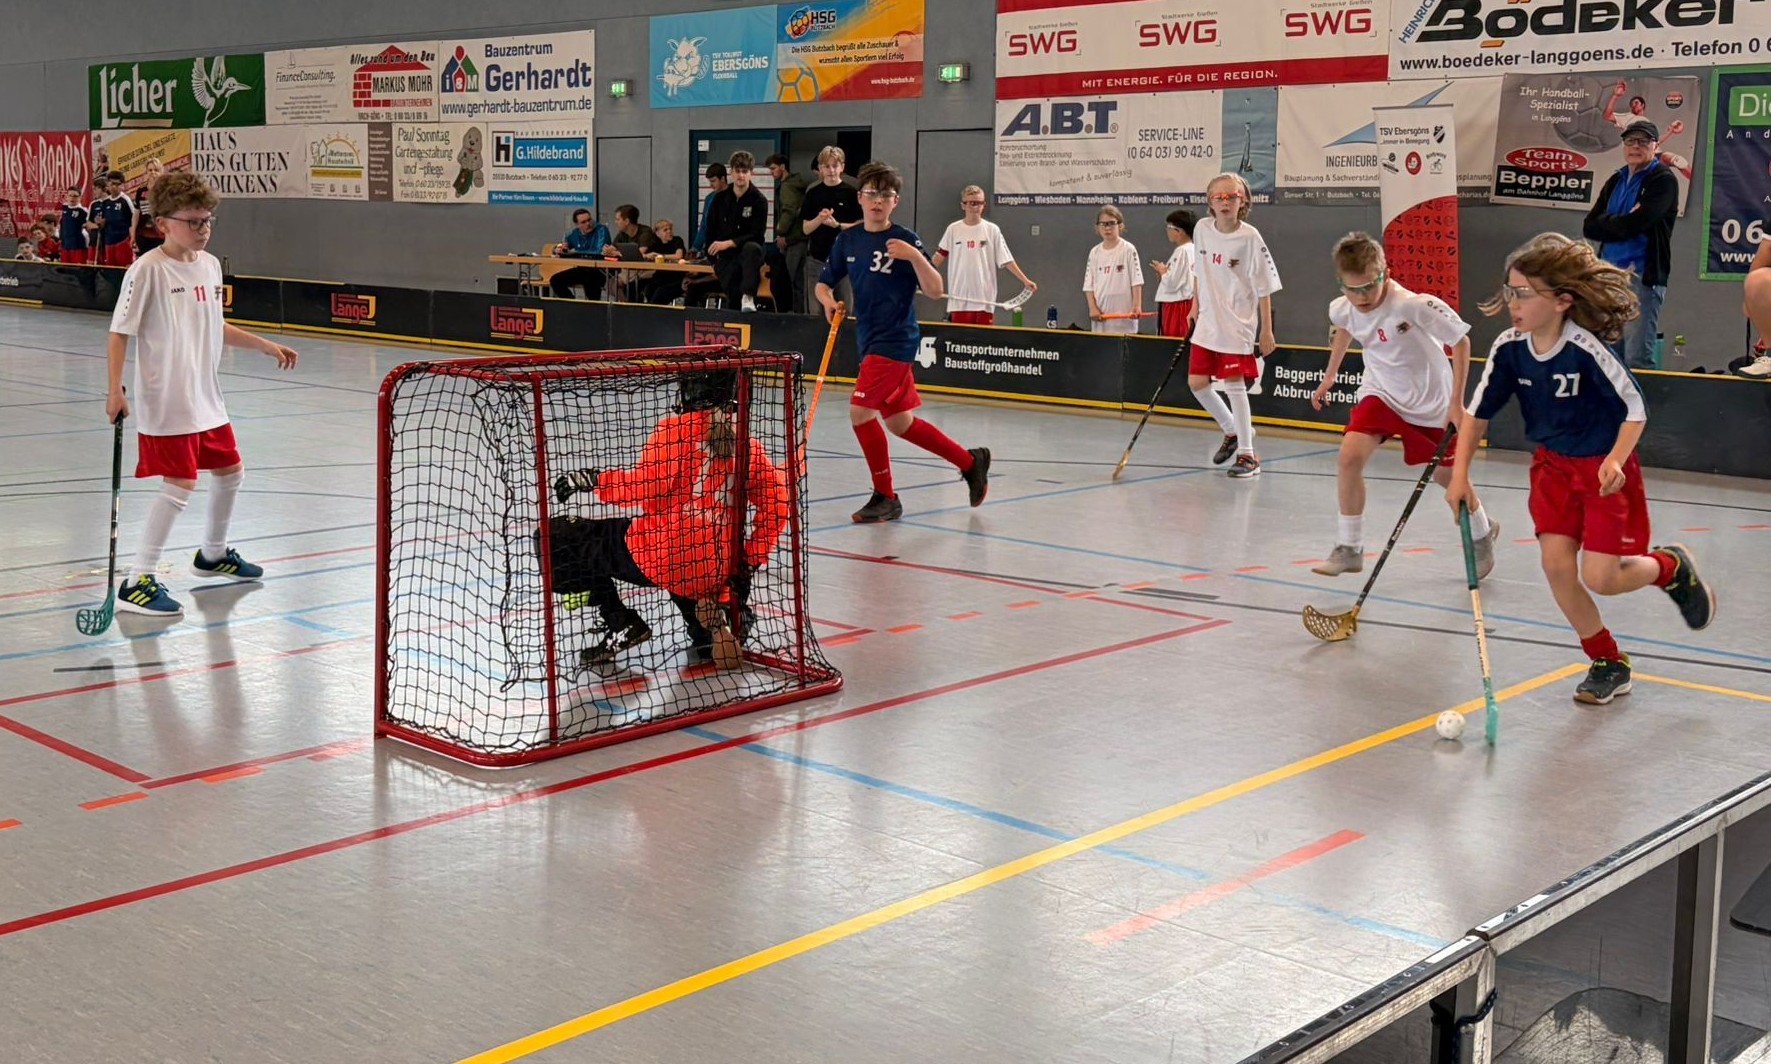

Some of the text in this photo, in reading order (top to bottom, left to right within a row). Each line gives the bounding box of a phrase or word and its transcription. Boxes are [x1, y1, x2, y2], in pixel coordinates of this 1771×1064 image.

[811, 10, 836, 25] HSG
[1285, 8, 1372, 37] SWG
[1139, 19, 1217, 47] SWG
[485, 44, 552, 58] Bauzentrum
[801, 45, 811, 53] HSG
[812, 44, 835, 52] Butzbach
[836, 42, 856, 52] begrüßt
[867, 40, 894, 50] Zuschauer
[1008, 30, 1077, 57] SWG
[350, 50, 435, 65] Alles rund um den Bau
[888, 52, 904, 61] Erfolg
[1400, 43, 1654, 70] www.boedeker-langgoens.de
[1671, 39, 1742, 57] Telefon
[1749, 37, 1760, 53] 0
[712, 54, 769, 72] EBERSGÖNS
[485, 58, 592, 92] Gerhardt
[1082, 70, 1278, 88] MIT ENERGIE. FÜR DIE REGION.
[373, 74, 433, 93] MARKUS MOHR
[99, 63, 178, 128] Licher
[1520, 86, 1590, 98] Ihr Handball-
[441, 96, 592, 118] www.gerhardt-bauzentrum.de
[1530, 100, 1579, 111] Spezialist
[1540, 114, 1572, 124] Langgöns
[398, 128, 450, 144] Paul Sonntag
[1138, 128, 1204, 142] SERVICE-LINE
[1380, 126, 1430, 137] TSV Ebersgöns
[194, 132, 236, 150] HAUS
[395, 147, 453, 161] Gartengestaltung
[1128, 145, 1213, 159] (0 64 03) 90 42-0
[1523, 149, 1573, 161] Team
[39, 134, 88, 200] BOARDS
[194, 152, 224, 172] DES
[230, 152, 290, 172] GUTEN
[404, 162, 417, 176] und
[1326, 155, 1378, 168] INGENIEURB
[1514, 157, 1579, 170] Sports
[203, 174, 278, 194] OHNENS
[1284, 174, 1324, 184] Bauplanung
[1326, 174, 1330, 182] &
[1333, 172, 1380, 182] Sachverständi
[1499, 170, 1591, 190] Beppler
[998, 196, 1029, 205] Langgöns
[1035, 195, 1071, 204] Wiesbaden
[1076, 195, 1113, 204] Mannheim
[1119, 194, 1148, 204] Koblenz
[1153, 194, 1184, 205] Freiburg
[1516, 188, 1548, 197] Bahnhof
[1549, 190, 1584, 200] Langgöns
[967, 240, 975, 248] 10
[869, 250, 894, 274] 32
[1212, 253, 1222, 265] 14
[194, 285, 206, 302] 11
[331, 292, 368, 324] Lange
[490, 305, 534, 340] Lange
[1377, 328, 1387, 342] 8
[944, 340, 1060, 361] Transportunternehmen
[944, 356, 1042, 376] Baustoffgroßhandel
[1552, 372, 1581, 398] 27
